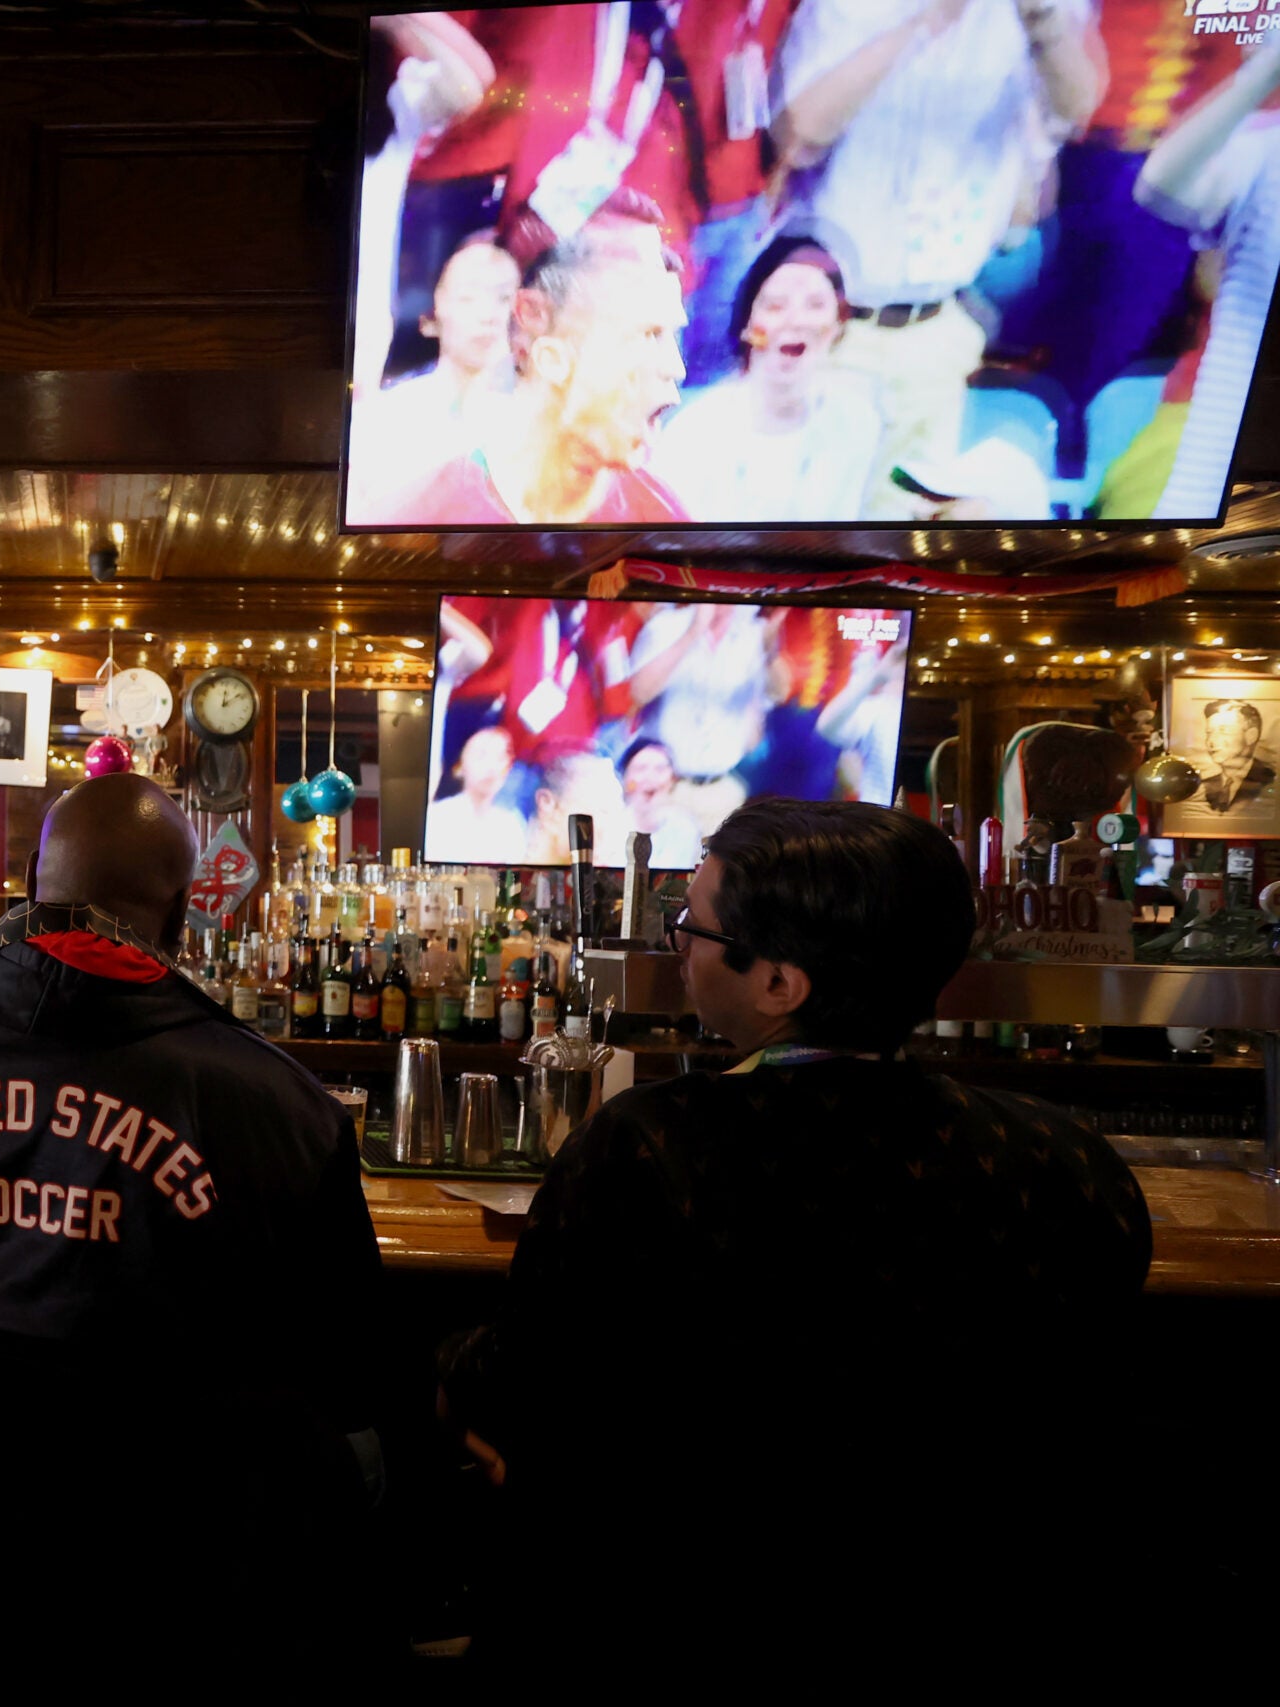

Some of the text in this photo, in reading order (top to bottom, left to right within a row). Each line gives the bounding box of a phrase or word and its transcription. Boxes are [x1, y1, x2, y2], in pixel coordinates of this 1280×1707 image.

[1193, 16, 1250, 34] FINAL
[1235, 33, 1264, 45] LIVE
[50, 1084, 219, 1219] STATES
